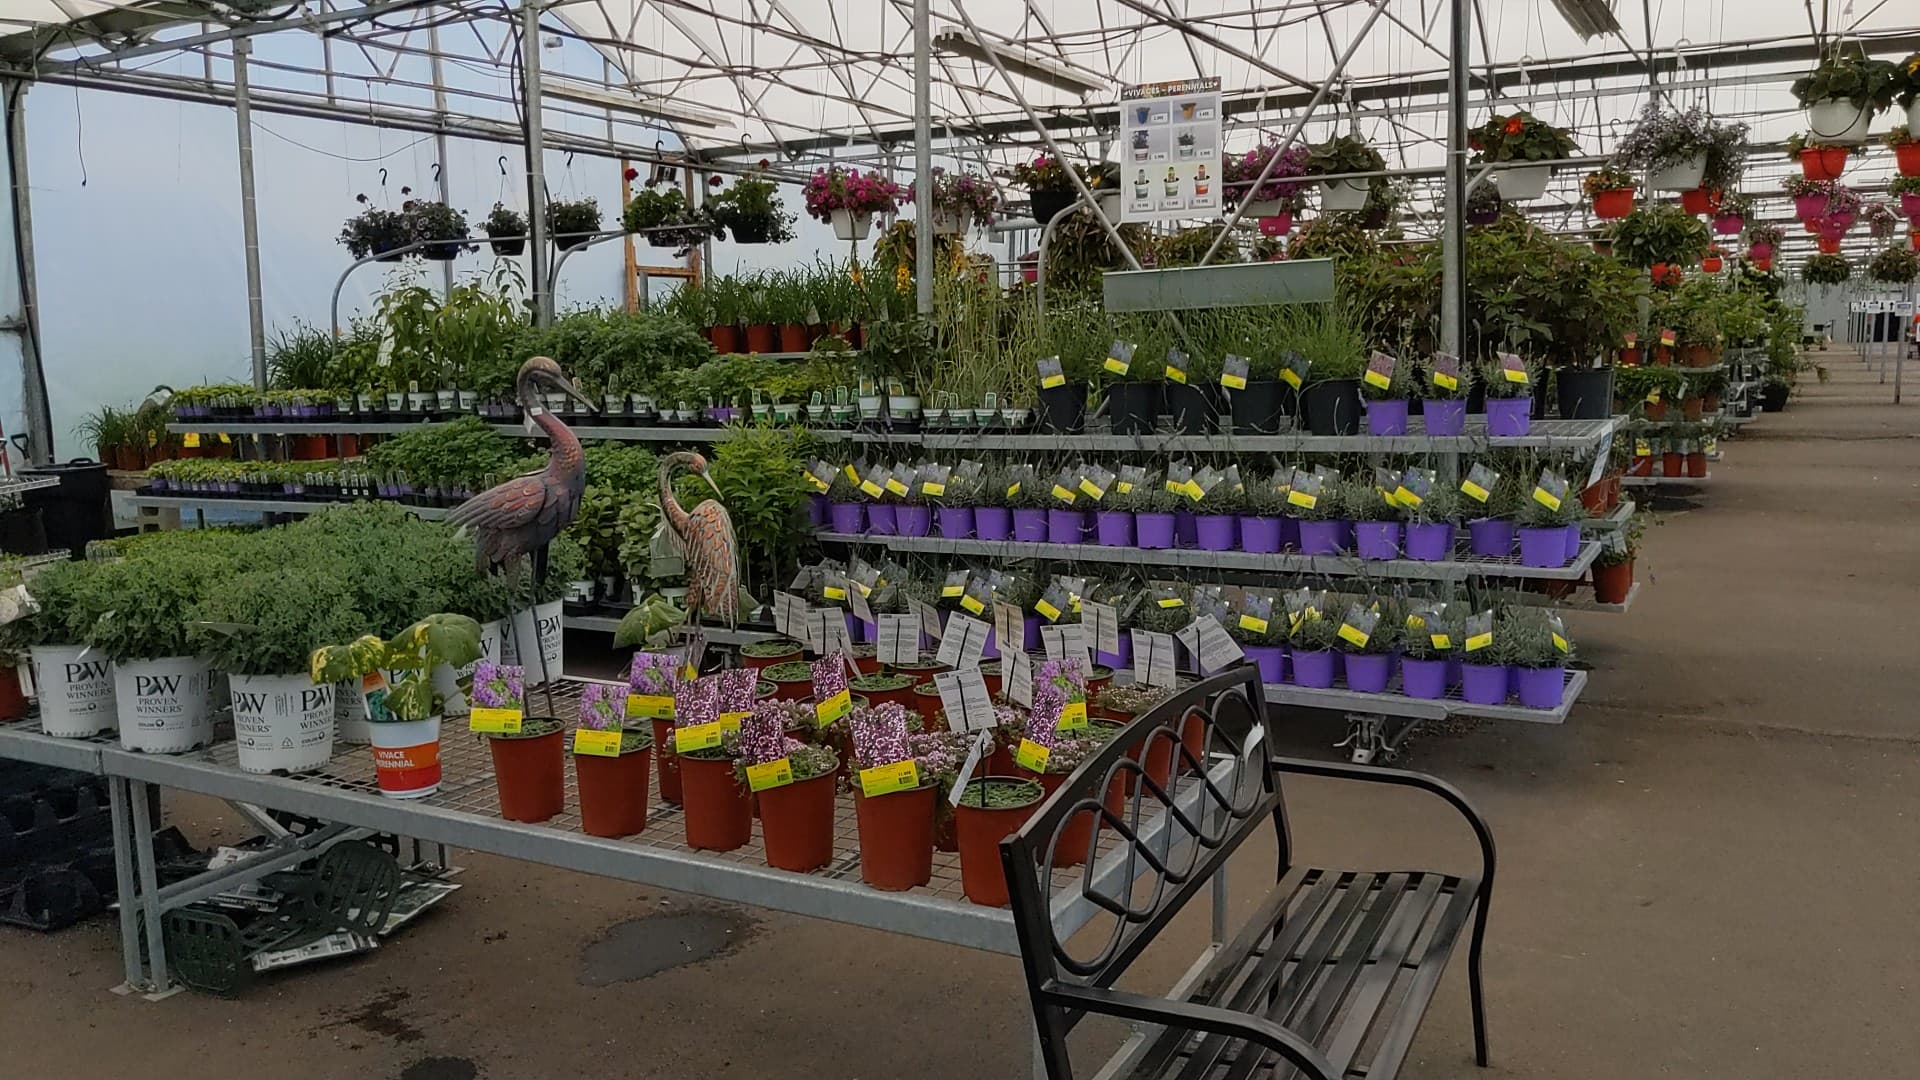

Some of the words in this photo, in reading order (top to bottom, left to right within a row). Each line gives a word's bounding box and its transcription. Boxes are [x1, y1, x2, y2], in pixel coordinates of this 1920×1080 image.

[1128, 87, 1160, 97] VIVACES
[1167, 81, 1214, 94] PERENNIALS
[64, 656, 112, 683] PW
[69, 680, 110, 691] PROVEN
[135, 674, 183, 696] PW
[138, 697, 178, 705] PROVEN
[233, 690, 269, 715] PW
[378, 751, 405, 760] VIVACE
